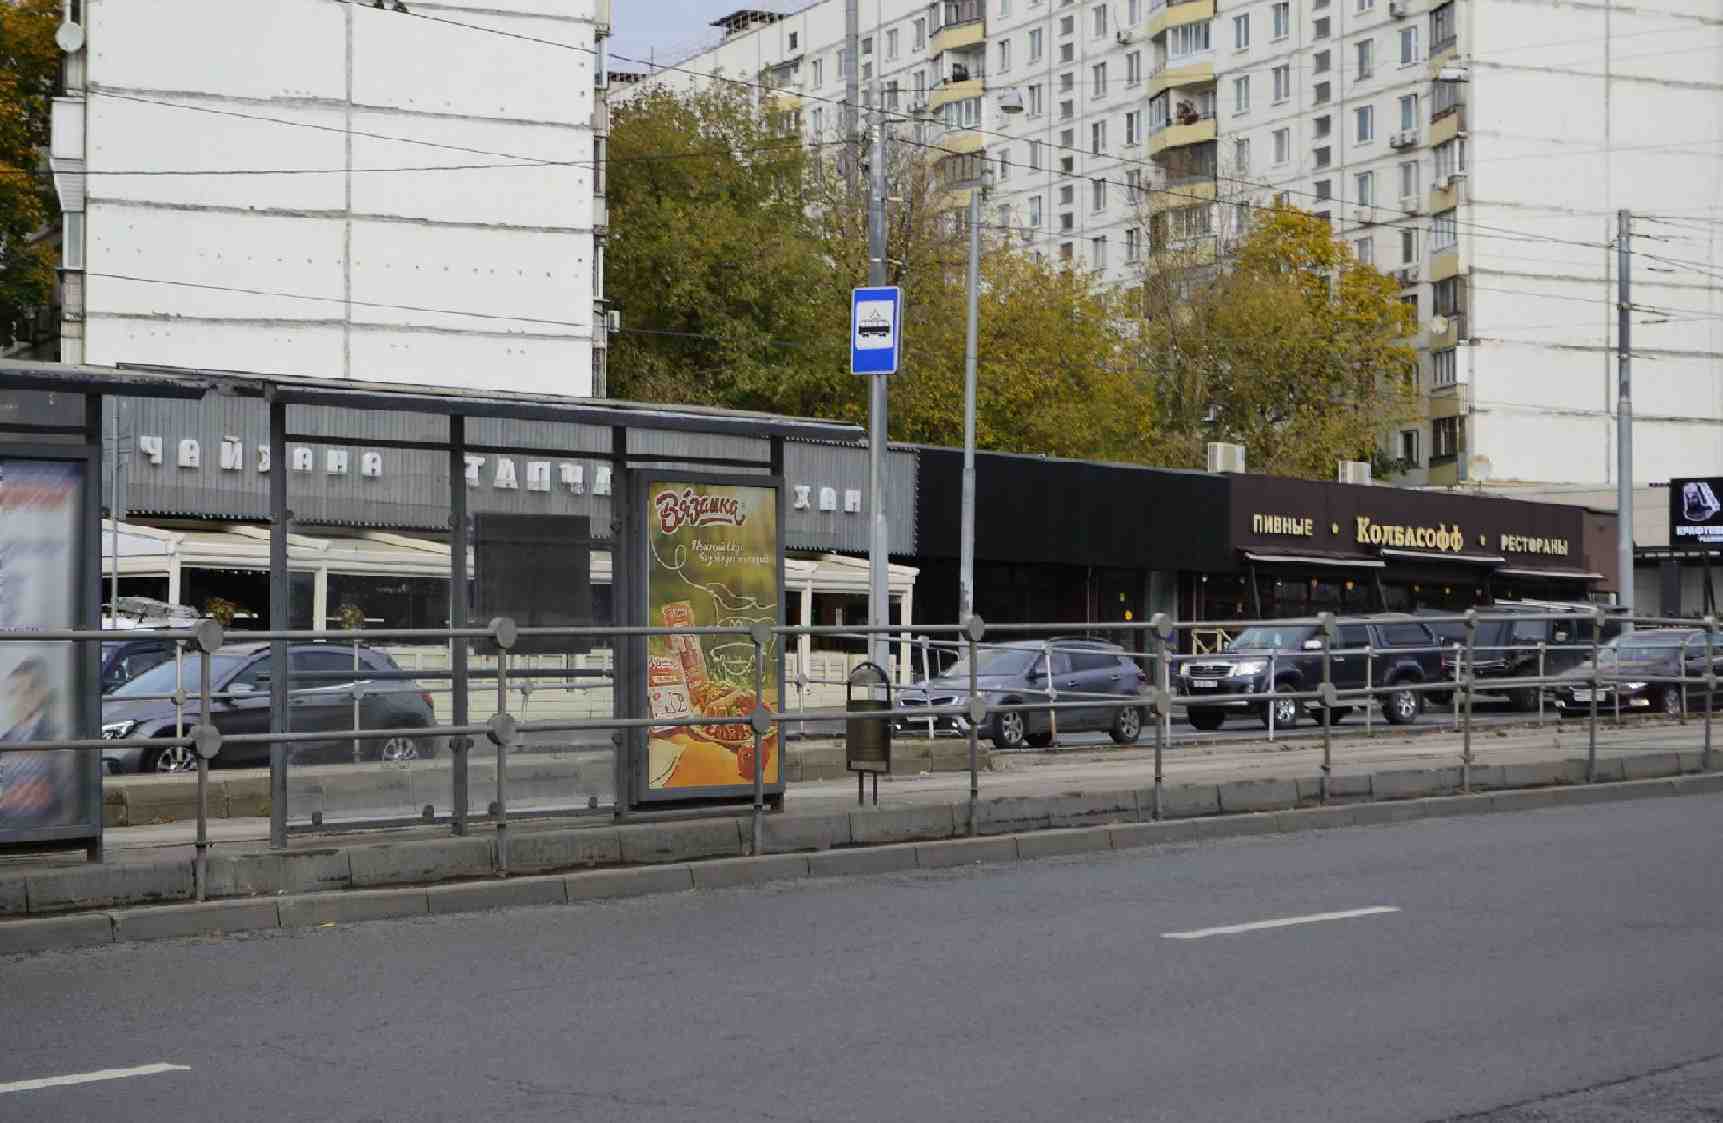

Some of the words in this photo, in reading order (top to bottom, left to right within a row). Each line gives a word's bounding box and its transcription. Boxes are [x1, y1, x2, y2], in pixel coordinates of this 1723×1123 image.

[464, 456, 612, 495] ТАПЧА
[1253, 513, 1313, 536] ПИВНЫЕ
[1500, 533, 1569, 556] РЕСТОРАНЫ
